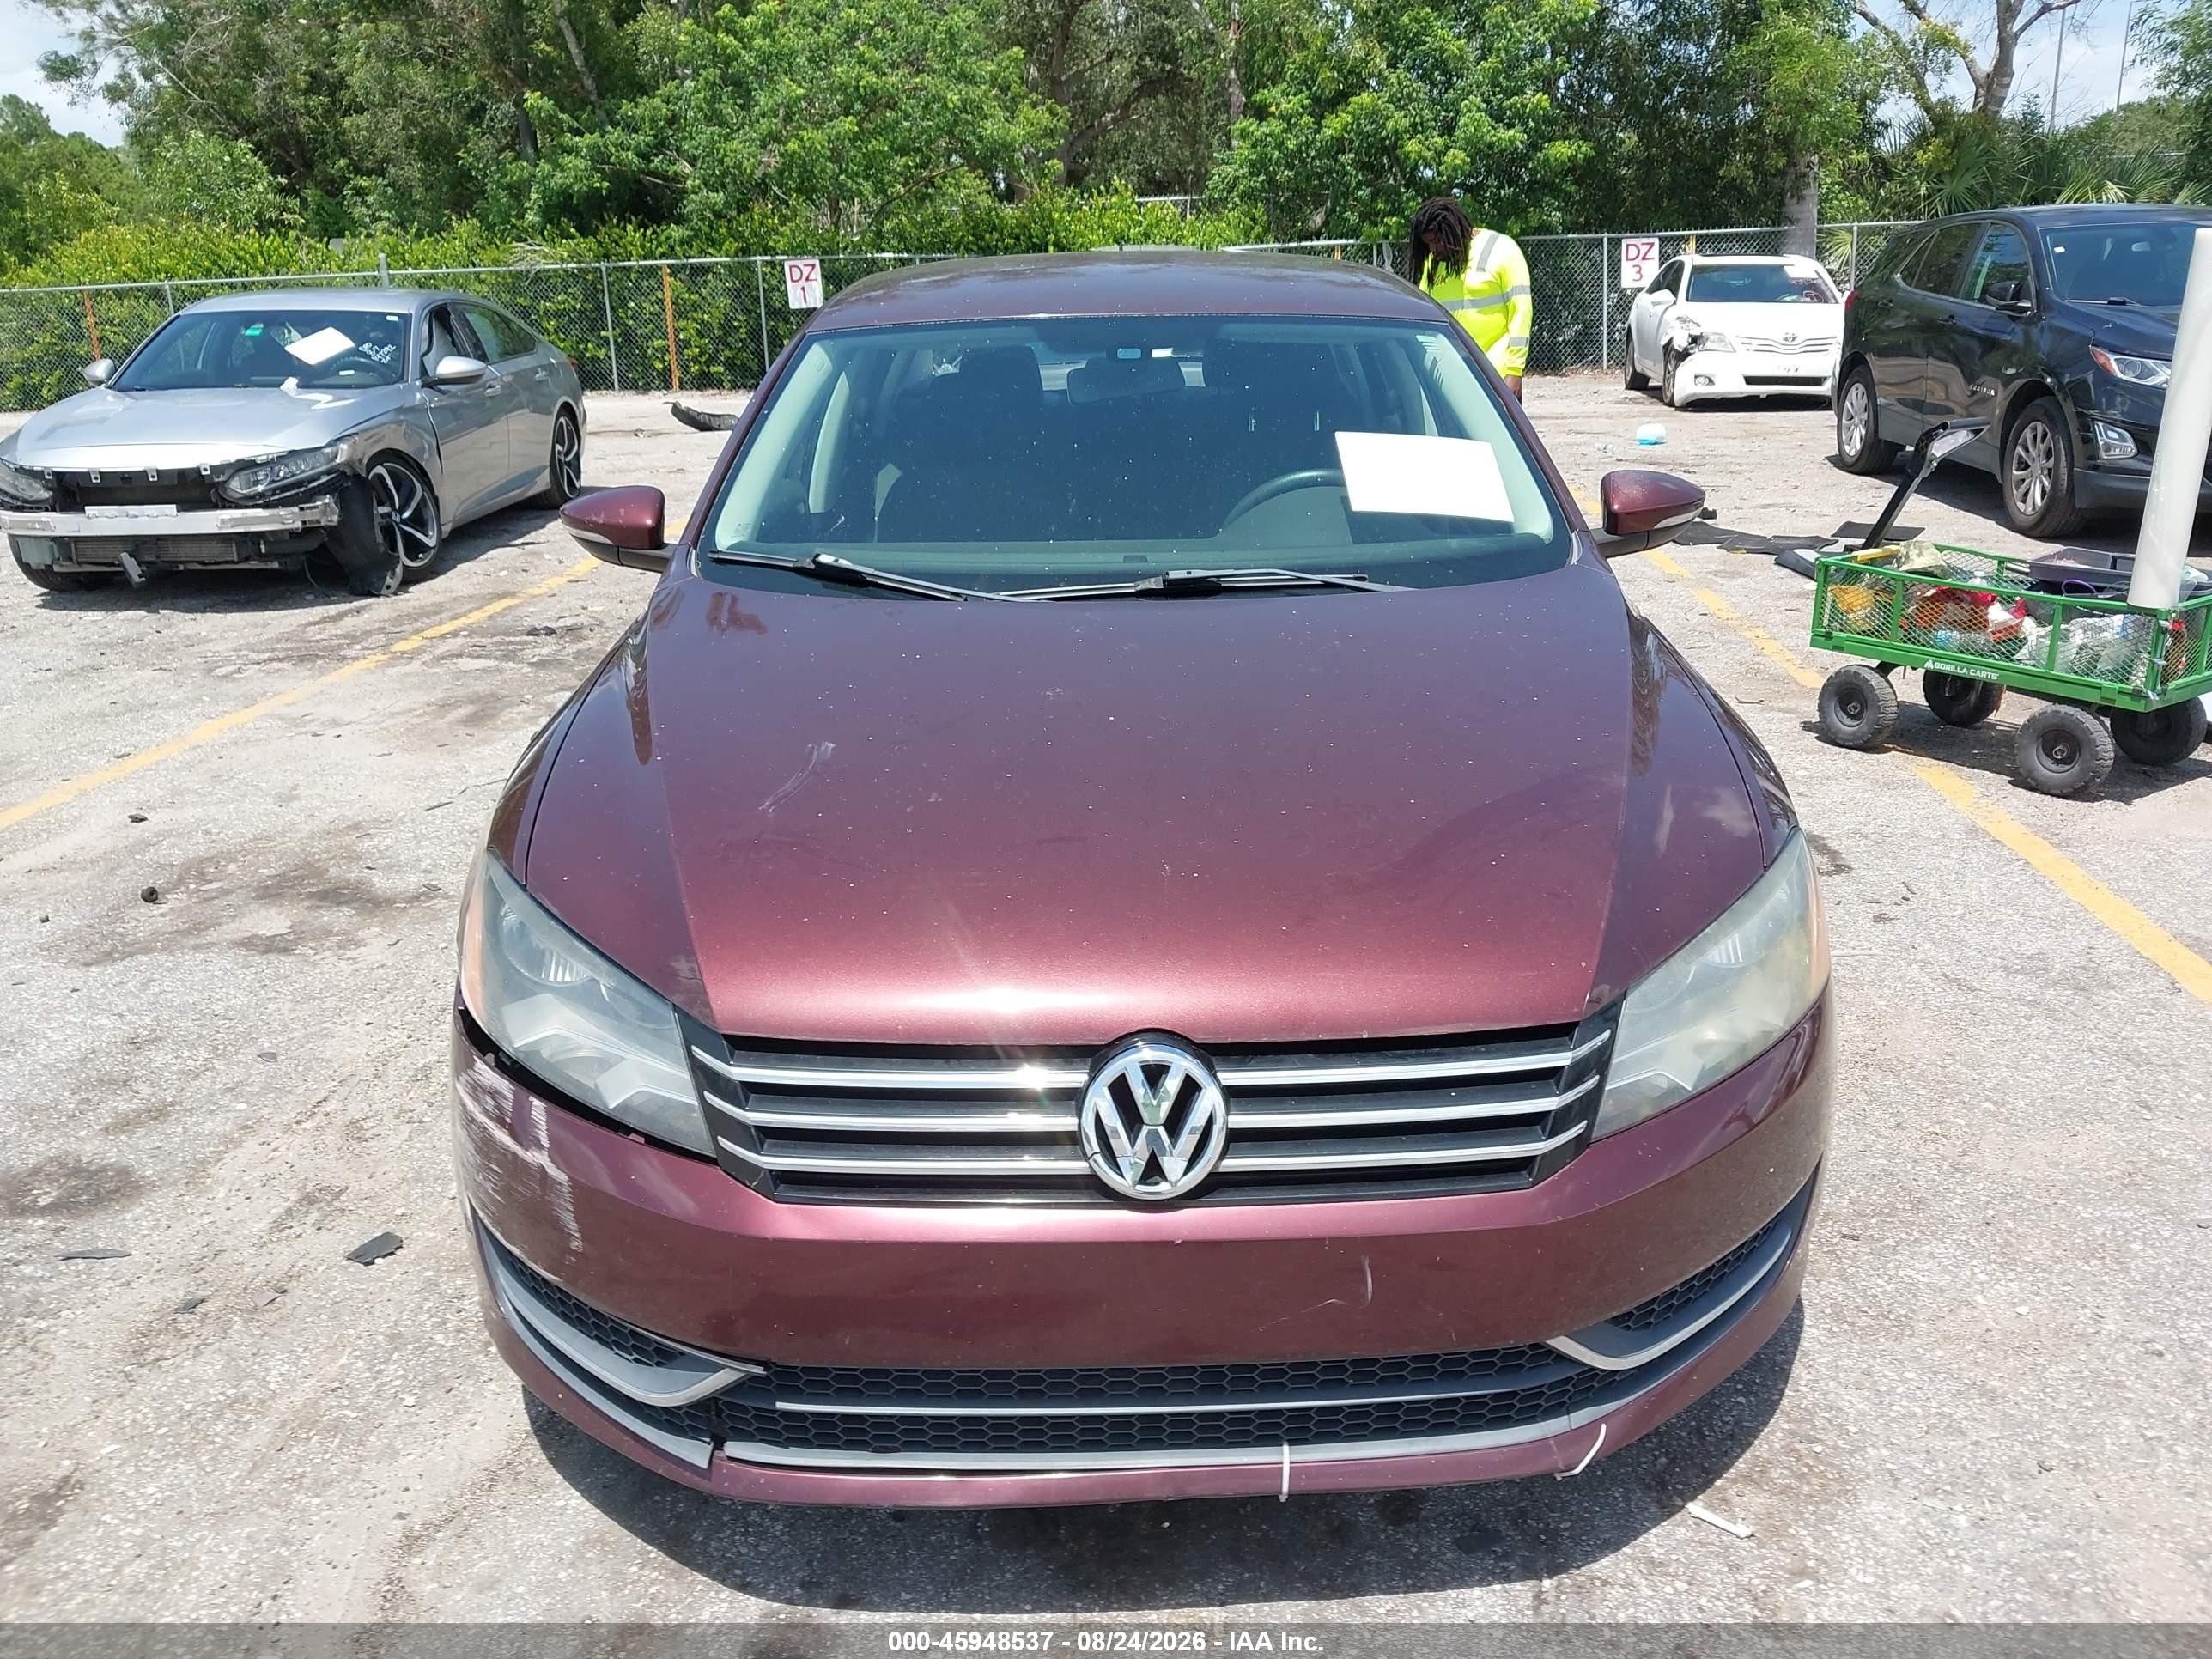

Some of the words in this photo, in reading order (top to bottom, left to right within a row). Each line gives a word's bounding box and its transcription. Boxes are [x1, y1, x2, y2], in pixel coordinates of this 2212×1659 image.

[1626, 241, 1656, 261] DZ
[788, 263, 818, 283] DZ
[1632, 264, 1644, 282] 3
[800, 285, 807, 303] 1
[1934, 661, 1969, 675] GORILLA
[1969, 669, 1998, 680] CARTS
[1084, 1051, 1224, 1195] VW
